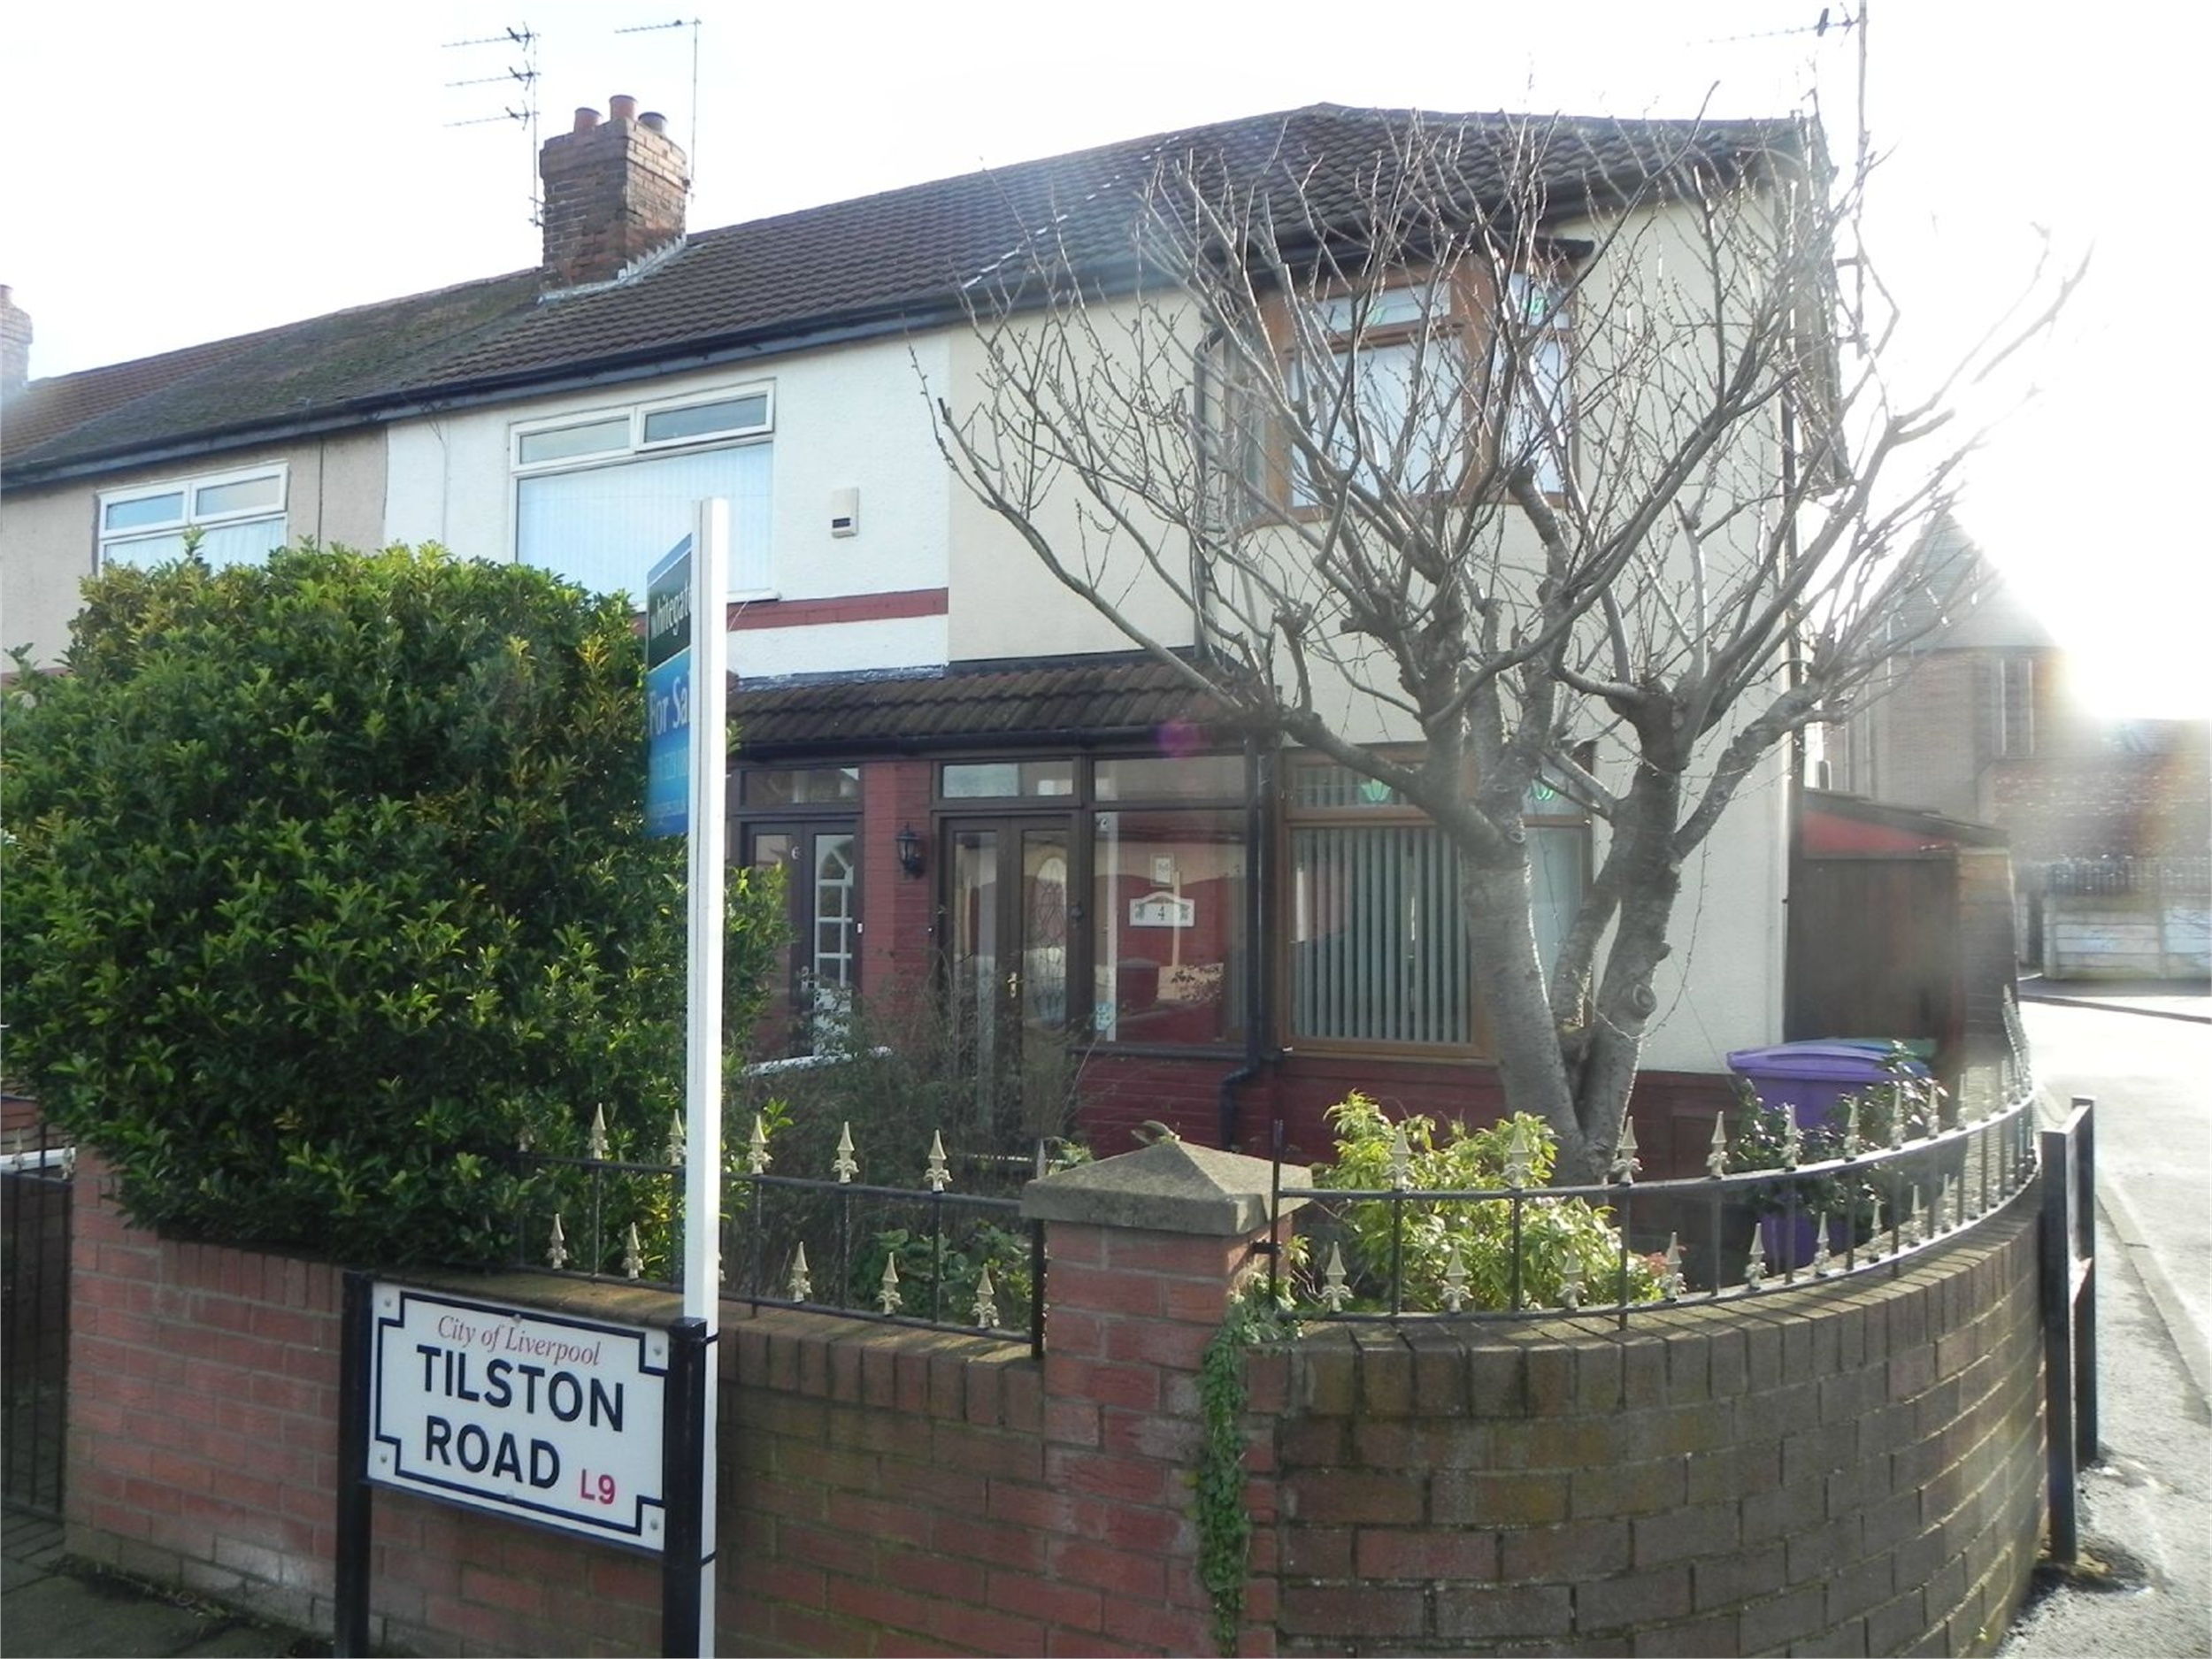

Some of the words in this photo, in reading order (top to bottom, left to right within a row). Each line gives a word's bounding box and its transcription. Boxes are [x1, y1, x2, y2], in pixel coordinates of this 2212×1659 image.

[438, 1315, 476, 1348] City
[480, 1324, 504, 1353] of
[505, 1326, 602, 1366] Liverpool
[416, 1343, 625, 1433] TILSTON
[425, 1415, 561, 1490] ROAD
[580, 1469, 616, 1505] L9
